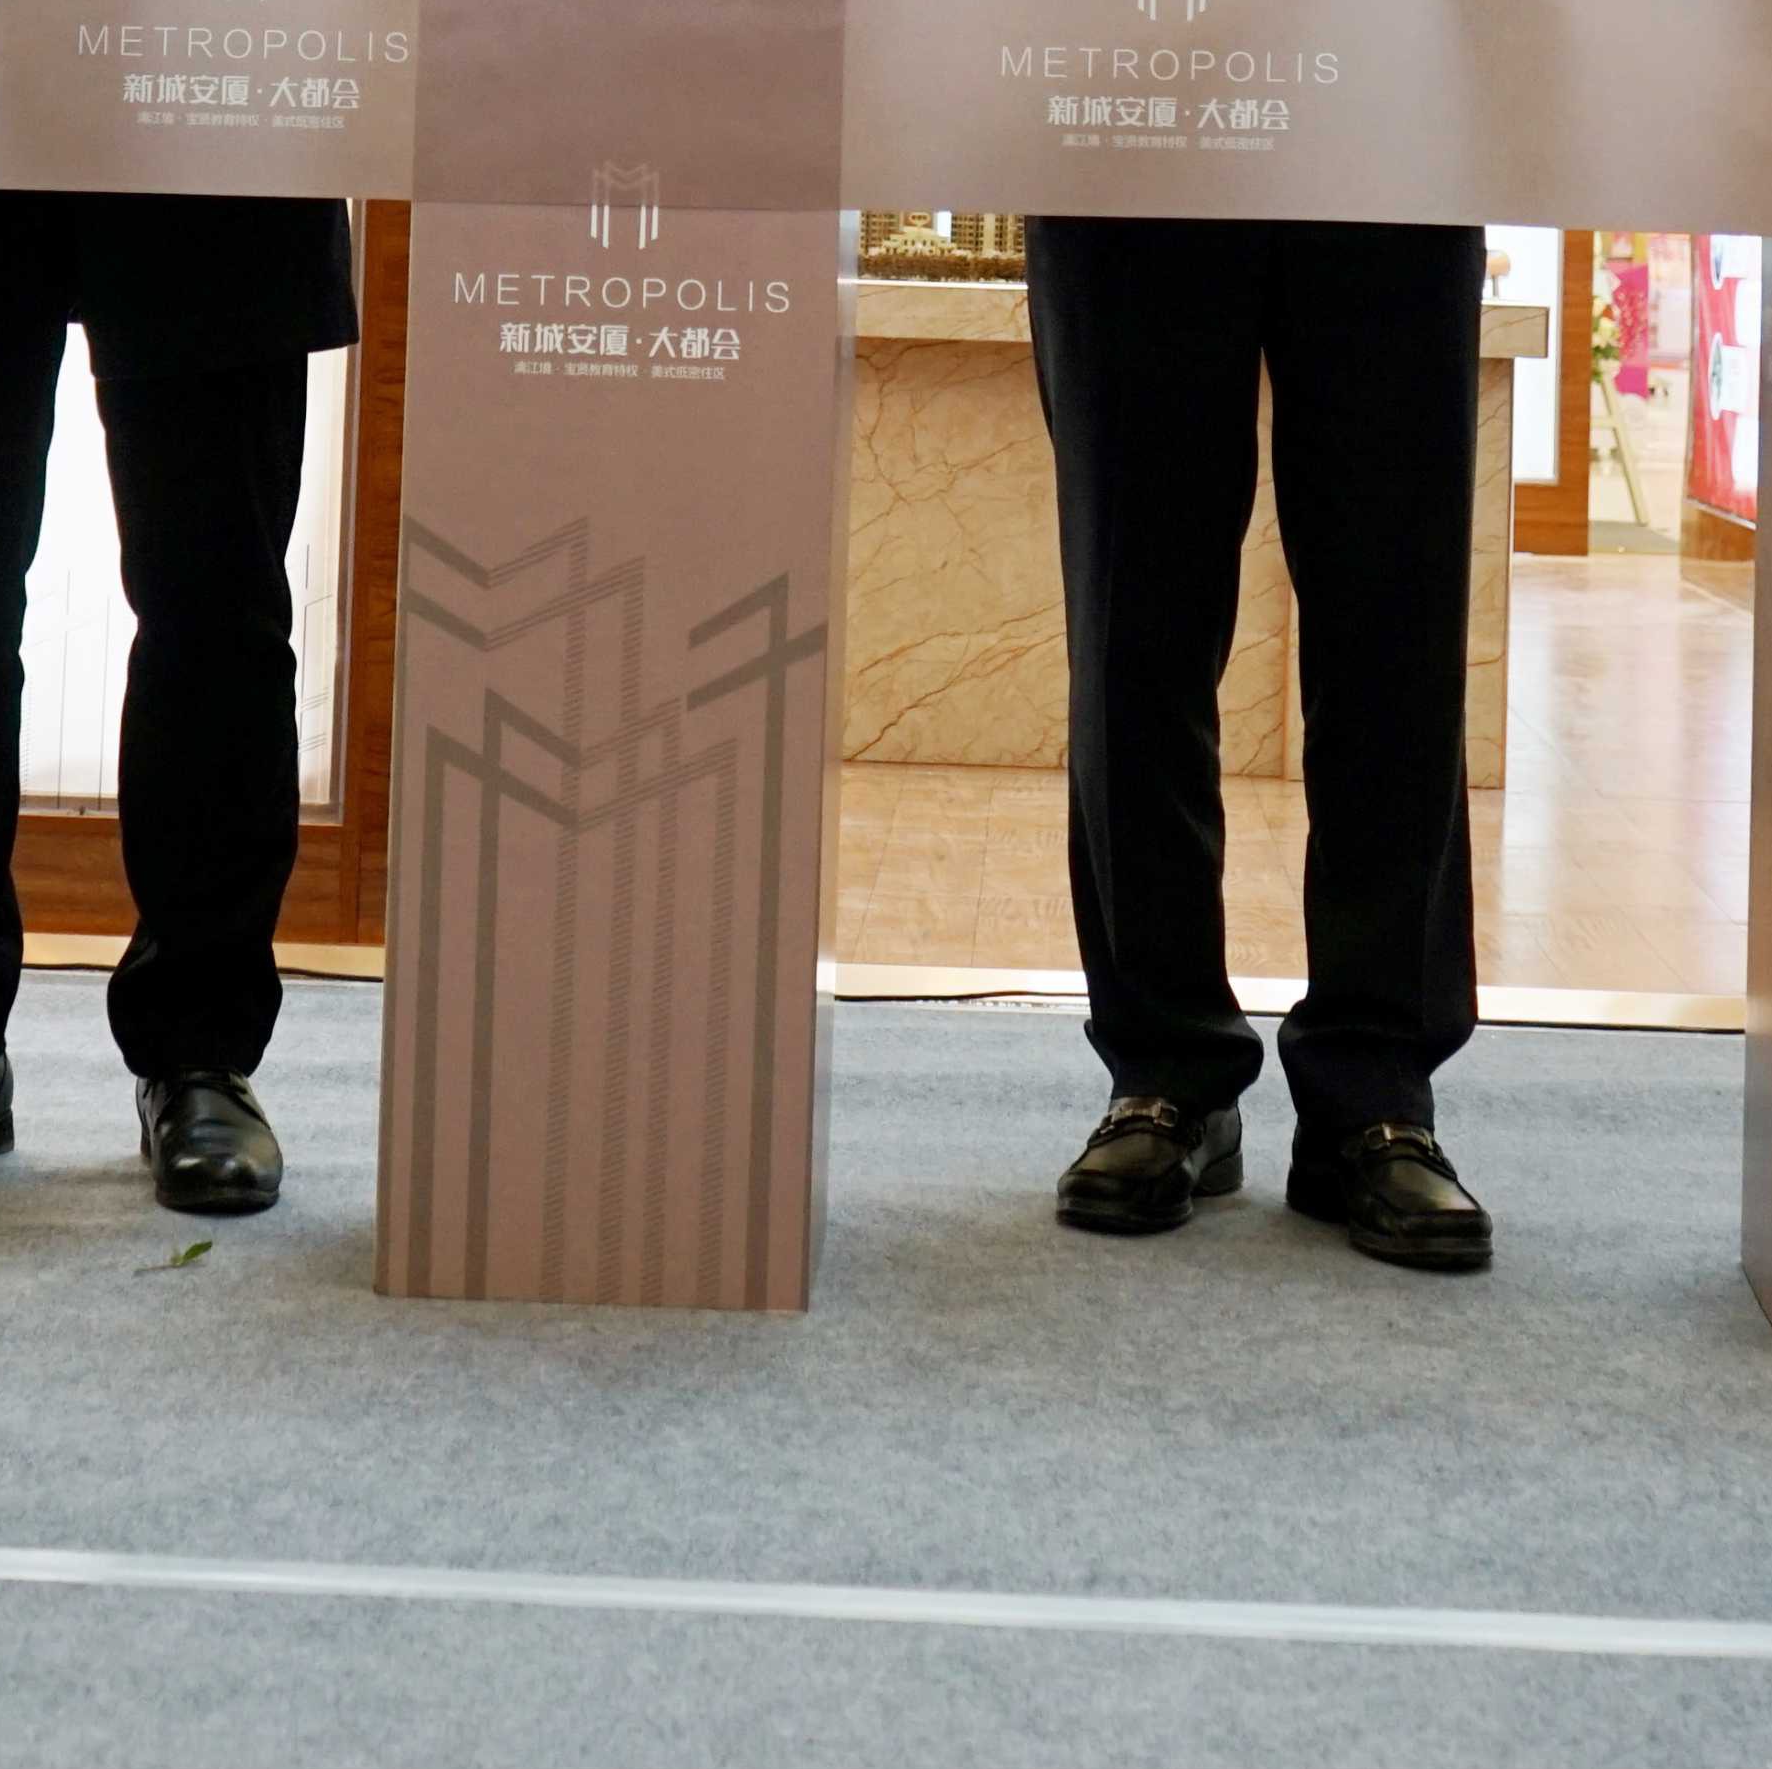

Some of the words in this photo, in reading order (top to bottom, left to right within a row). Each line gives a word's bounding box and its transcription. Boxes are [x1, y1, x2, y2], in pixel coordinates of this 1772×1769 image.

[77, 24, 411, 64] METROPOLIS
[999, 45, 1341, 85] METROPOLIS
[122, 73, 361, 111] 新城安厦·大都会
[1046, 94, 1292, 132] 新城安厦·大都会
[452, 270, 793, 314] METROPOLIS
[499, 321, 742, 362] 新城安厦·大都会
